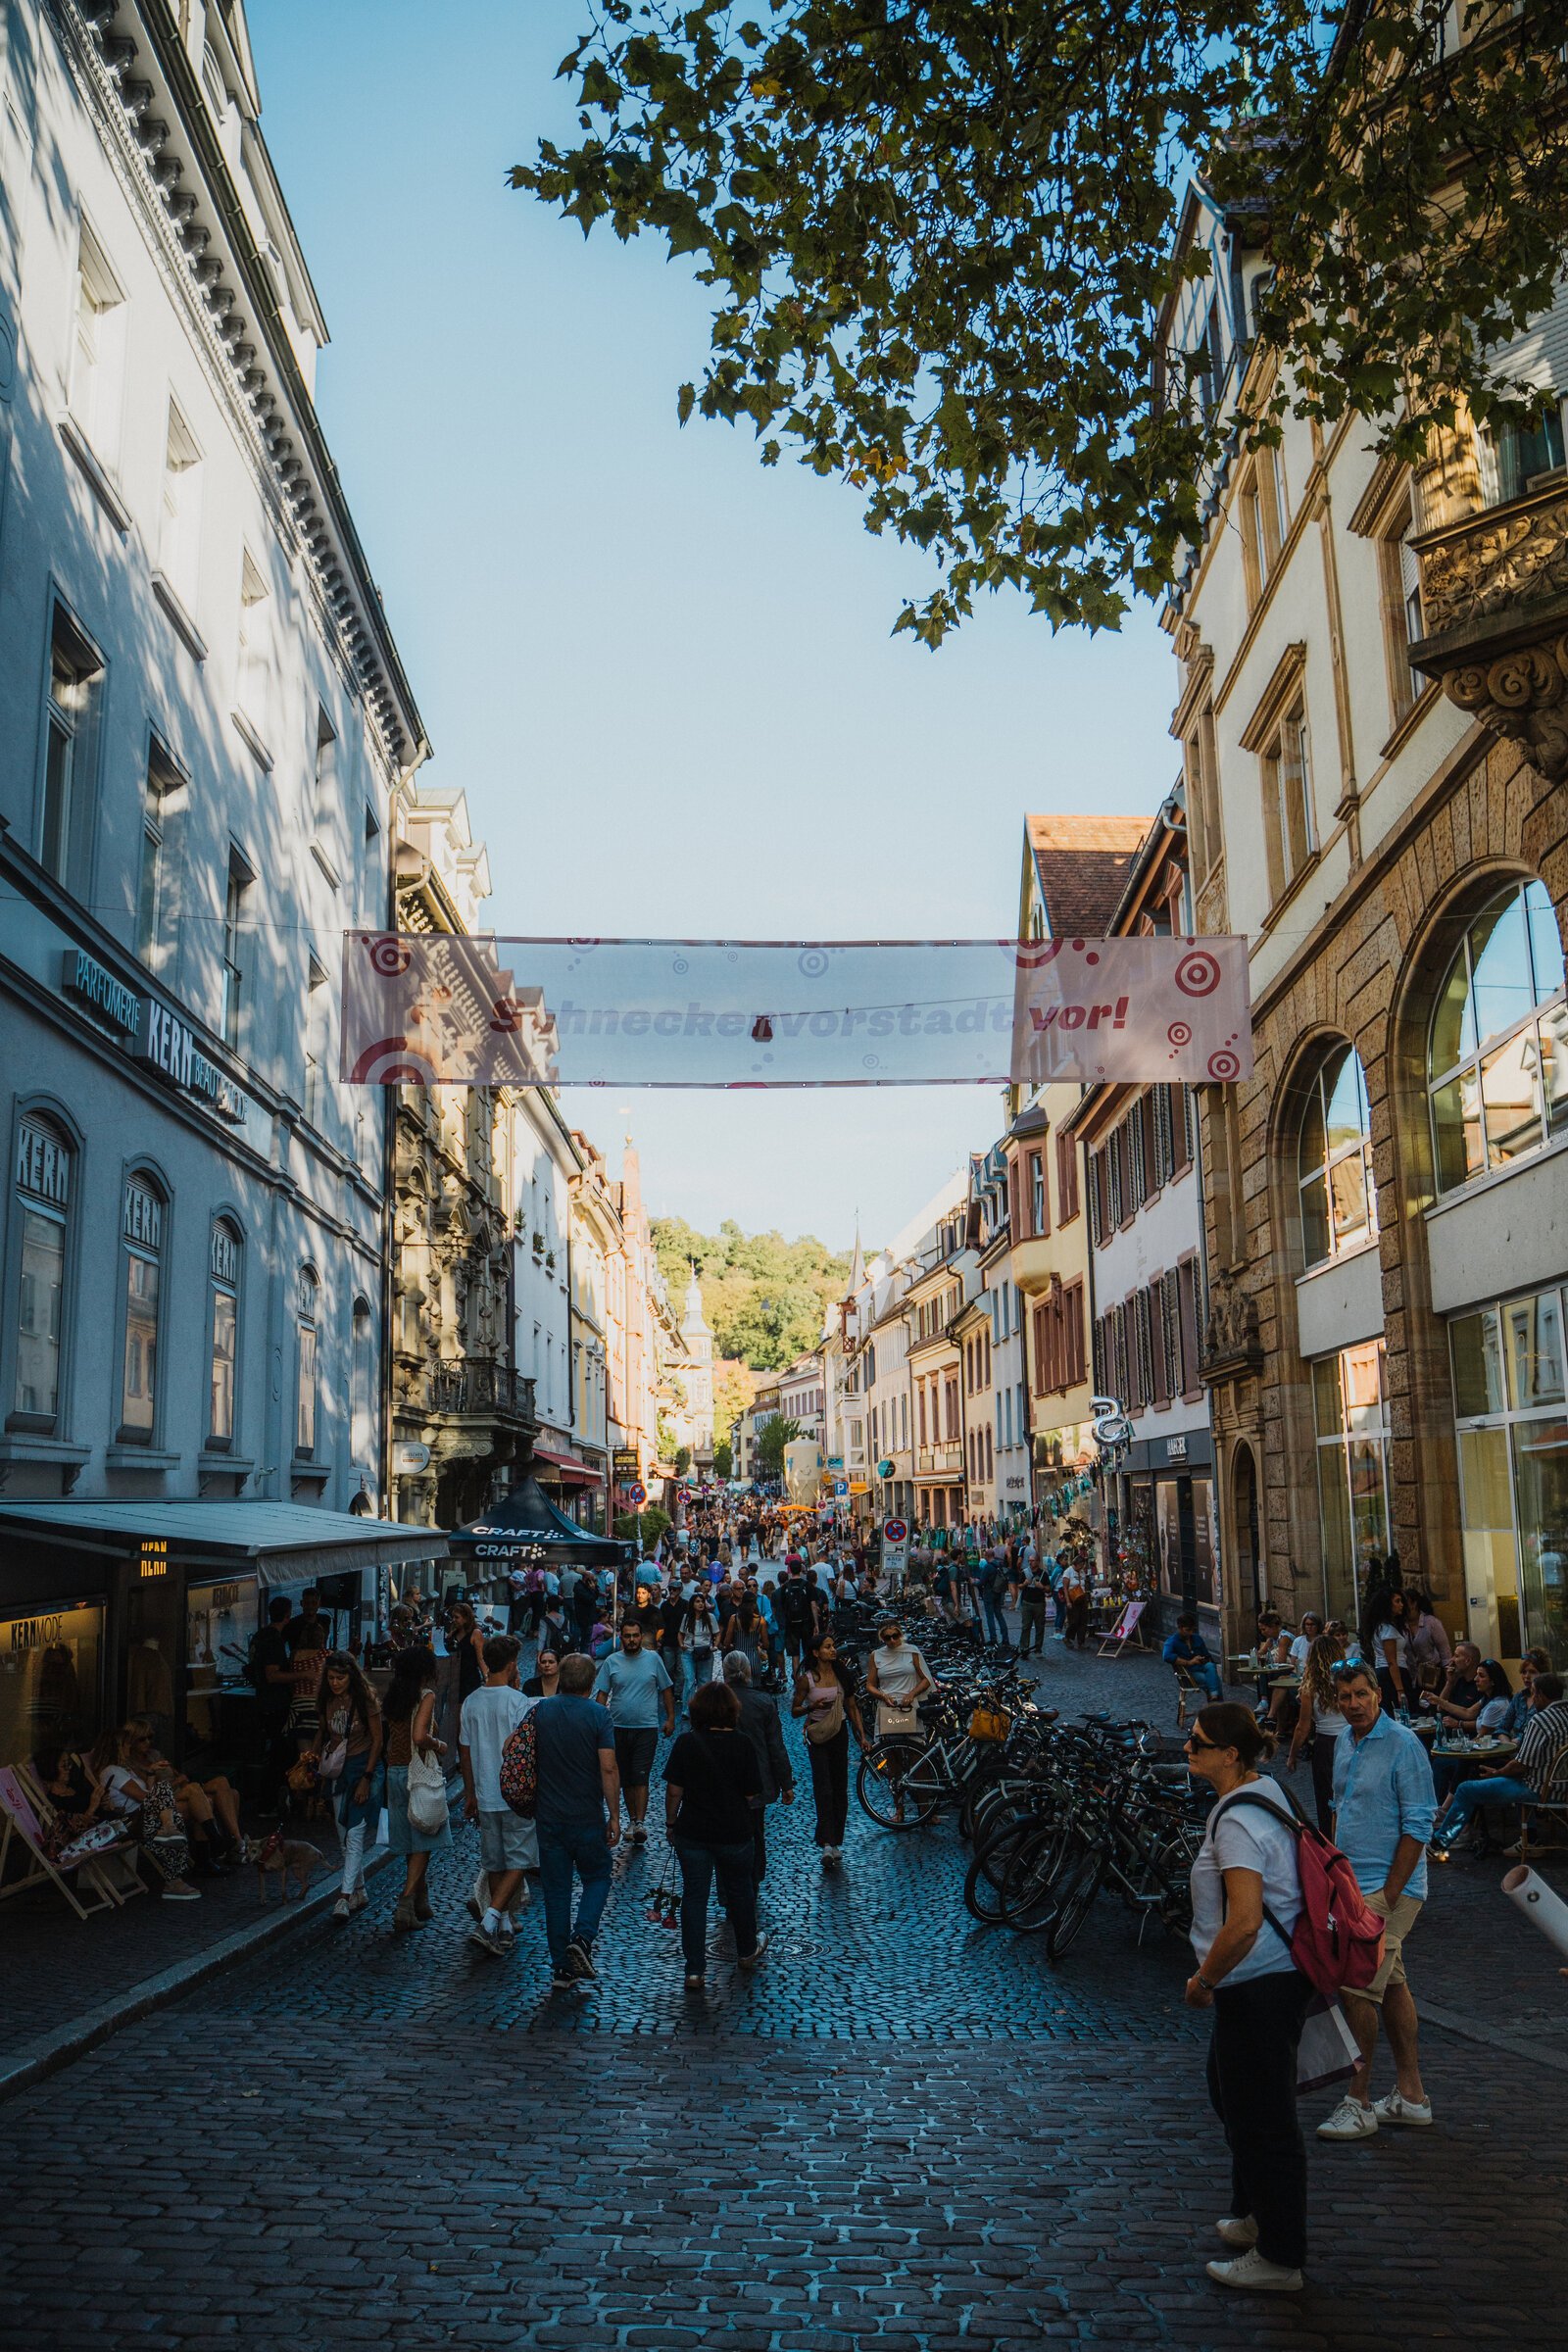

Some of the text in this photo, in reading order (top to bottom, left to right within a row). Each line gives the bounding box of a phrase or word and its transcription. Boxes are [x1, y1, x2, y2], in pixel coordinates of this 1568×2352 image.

[1029, 996, 1129, 1031] vor!
[147, 999, 193, 1089] KERN
[17, 1127, 70, 1204] KERN
[124, 1187, 161, 1250] KERN
[471, 1526, 546, 1538] CRAFT
[474, 1544, 532, 1557] CRAFT
[11, 1614, 63, 1651] KERNMODE
